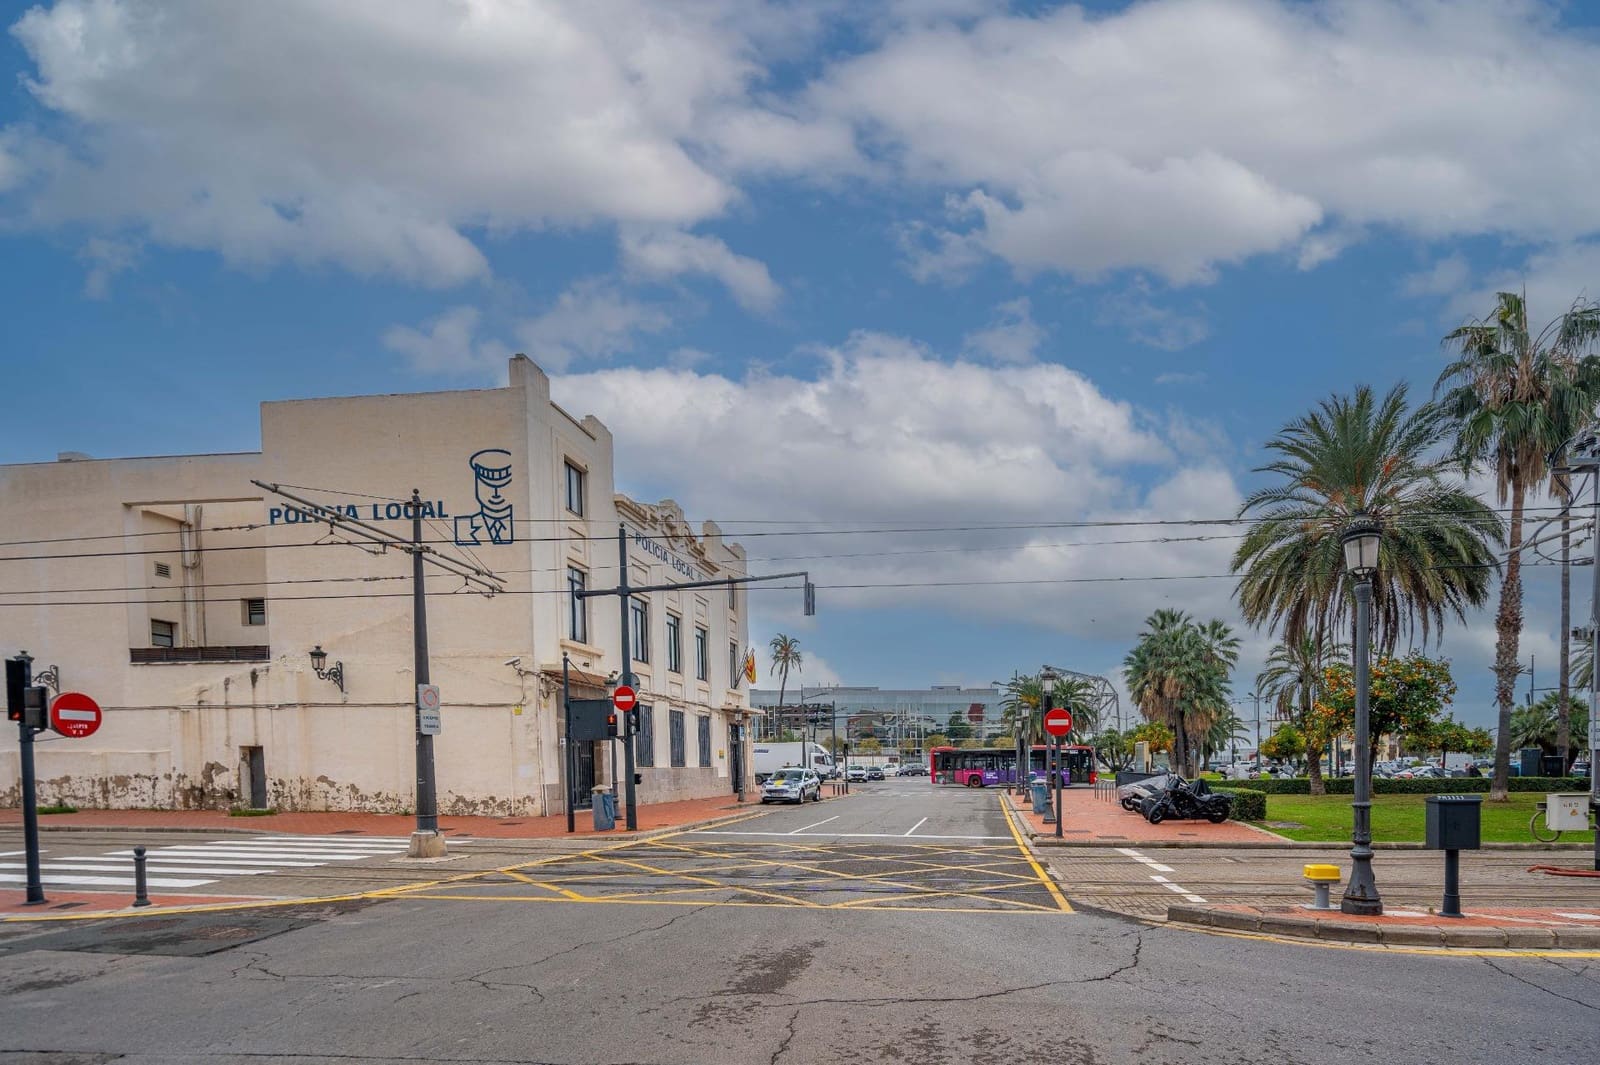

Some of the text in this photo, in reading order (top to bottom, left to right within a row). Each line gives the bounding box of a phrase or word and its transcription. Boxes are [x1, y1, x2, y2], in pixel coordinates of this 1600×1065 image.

[372, 500, 449, 521] LOCAL
[635, 532, 694, 580] POLICIA LOCAL
